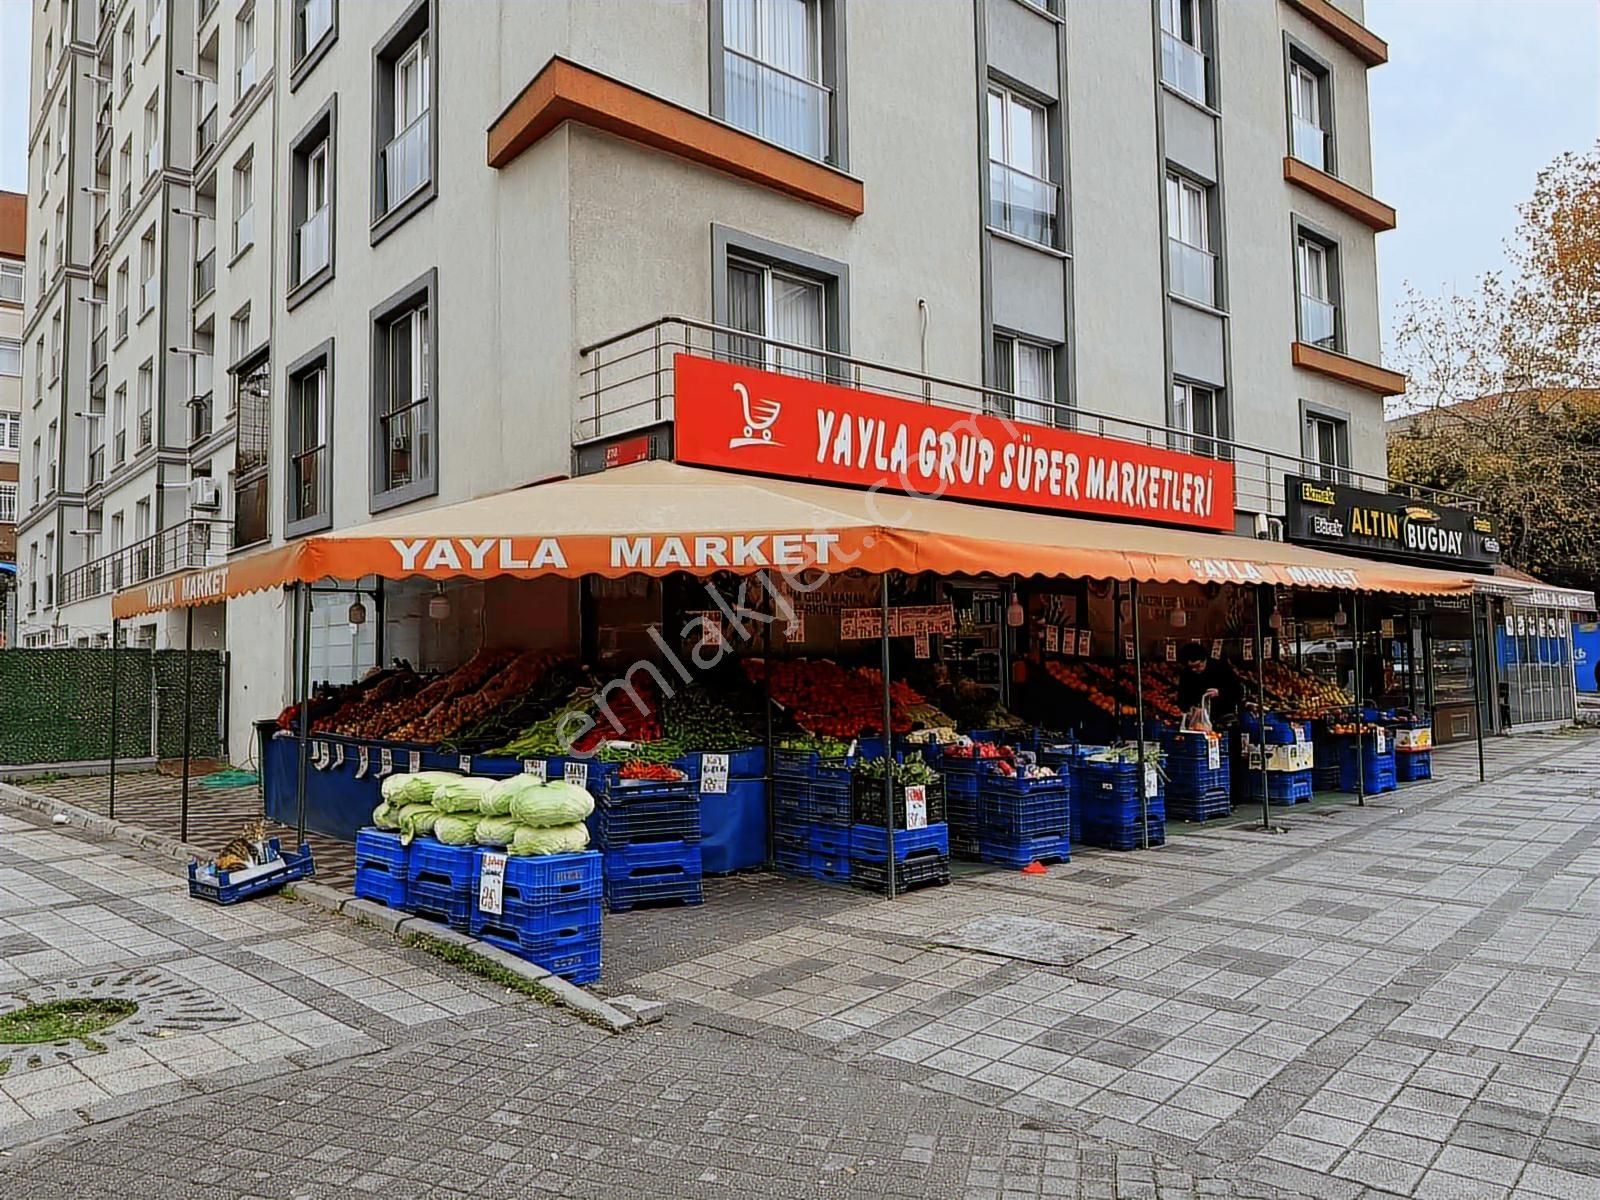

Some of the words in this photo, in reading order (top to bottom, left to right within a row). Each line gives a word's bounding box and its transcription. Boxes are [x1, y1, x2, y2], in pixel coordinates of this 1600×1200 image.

[816, 408, 908, 474] YAYLA
[918, 427, 995, 485] GRUP
[1000, 434, 1079, 501] SÜPER
[1085, 456, 1215, 518] MARKETLERİ
[1302, 483, 1335, 505] Ekmek
[1351, 506, 1398, 540] ALTIN
[390, 538, 569, 570] YAYLA
[610, 533, 840, 568] MARKET
[145, 580, 175, 607] YAYLA
[181, 566, 229, 601] MARKET
[1286, 566, 1359, 586] MARKET
